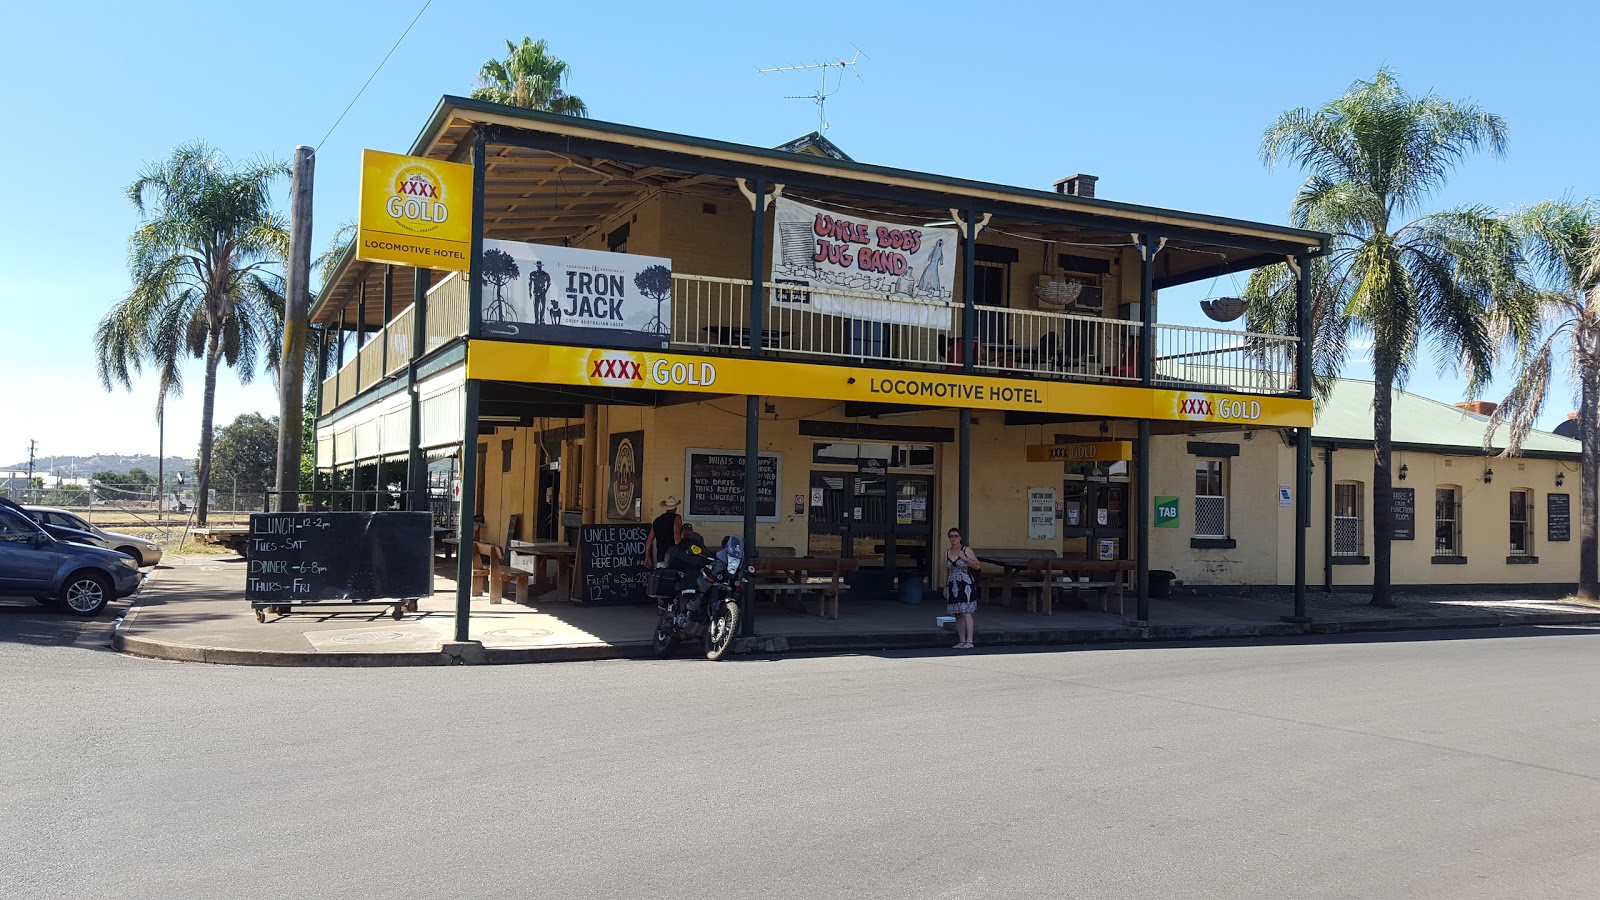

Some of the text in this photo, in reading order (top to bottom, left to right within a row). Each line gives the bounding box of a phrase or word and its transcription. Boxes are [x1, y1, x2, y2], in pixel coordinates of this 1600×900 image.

[398, 182, 438, 199] XXXX
[386, 196, 448, 223] GOLD
[814, 213, 870, 244] UNCLE
[365, 240, 466, 260] LOCOMOTIVE HOTEL
[812, 239, 907, 276] JUG BAND
[566, 271, 624, 297] IRON
[564, 294, 624, 320] JACK
[590, 359, 716, 386] XXXX GOLD
[870, 378, 1042, 403] LOCOMOTIVE HOTEL
[1180, 398, 1261, 420] XXXX GOLD
[1049, 445, 1096, 458] XXXX GOLD
[1393, 492, 1407, 500] HIRE
[1159, 507, 1176, 517] TAB
[584, 527, 647, 542] UNCLE BOB'S
[592, 542, 646, 558] JUG BAND
[252, 560, 288, 574] DINNER
[592, 557, 611, 568] HERE
[613, 556, 634, 568] DAILY
